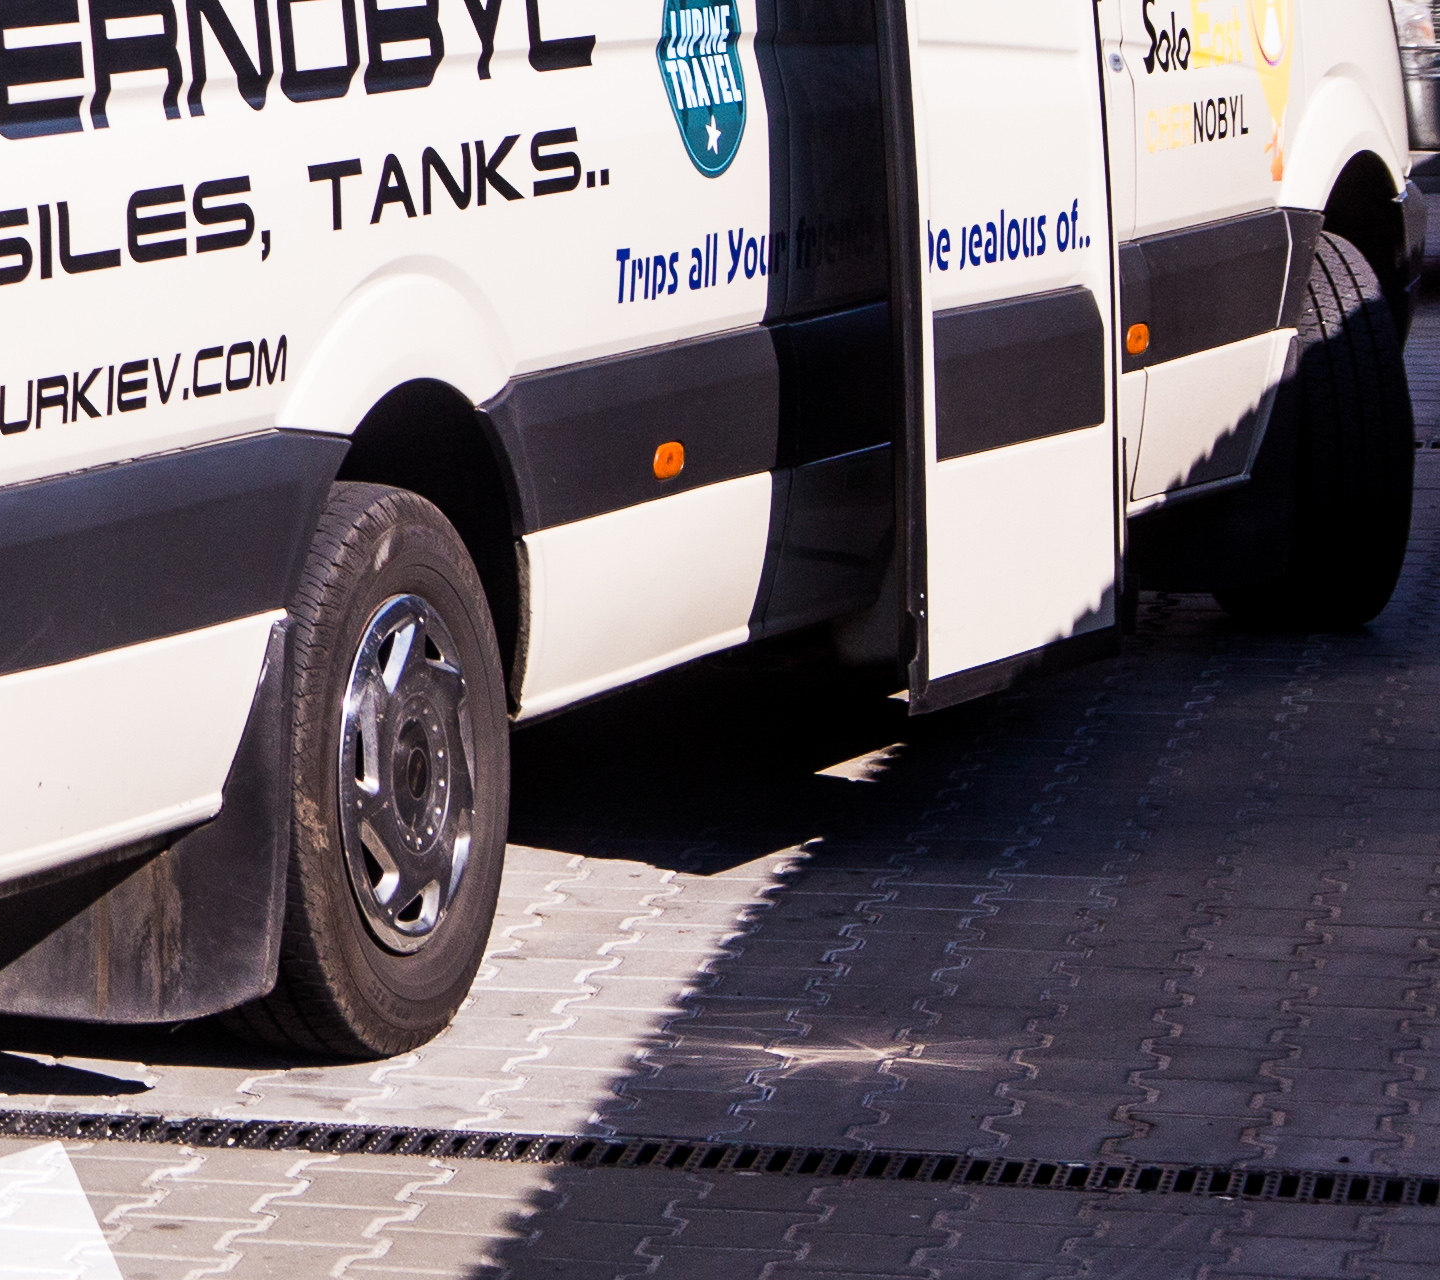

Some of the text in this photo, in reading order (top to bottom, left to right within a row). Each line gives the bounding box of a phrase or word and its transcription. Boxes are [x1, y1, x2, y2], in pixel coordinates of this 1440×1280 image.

[666, 4, 731, 60] LUPINE
[664, 53, 743, 111] TRAVEL
[1145, 93, 1249, 155] CHERNOBYL
[307, 126, 611, 232] TANKS..
[615, 247, 680, 304] Trips
[688, 232, 719, 291] all
[959, 208, 1047, 271] jealous
